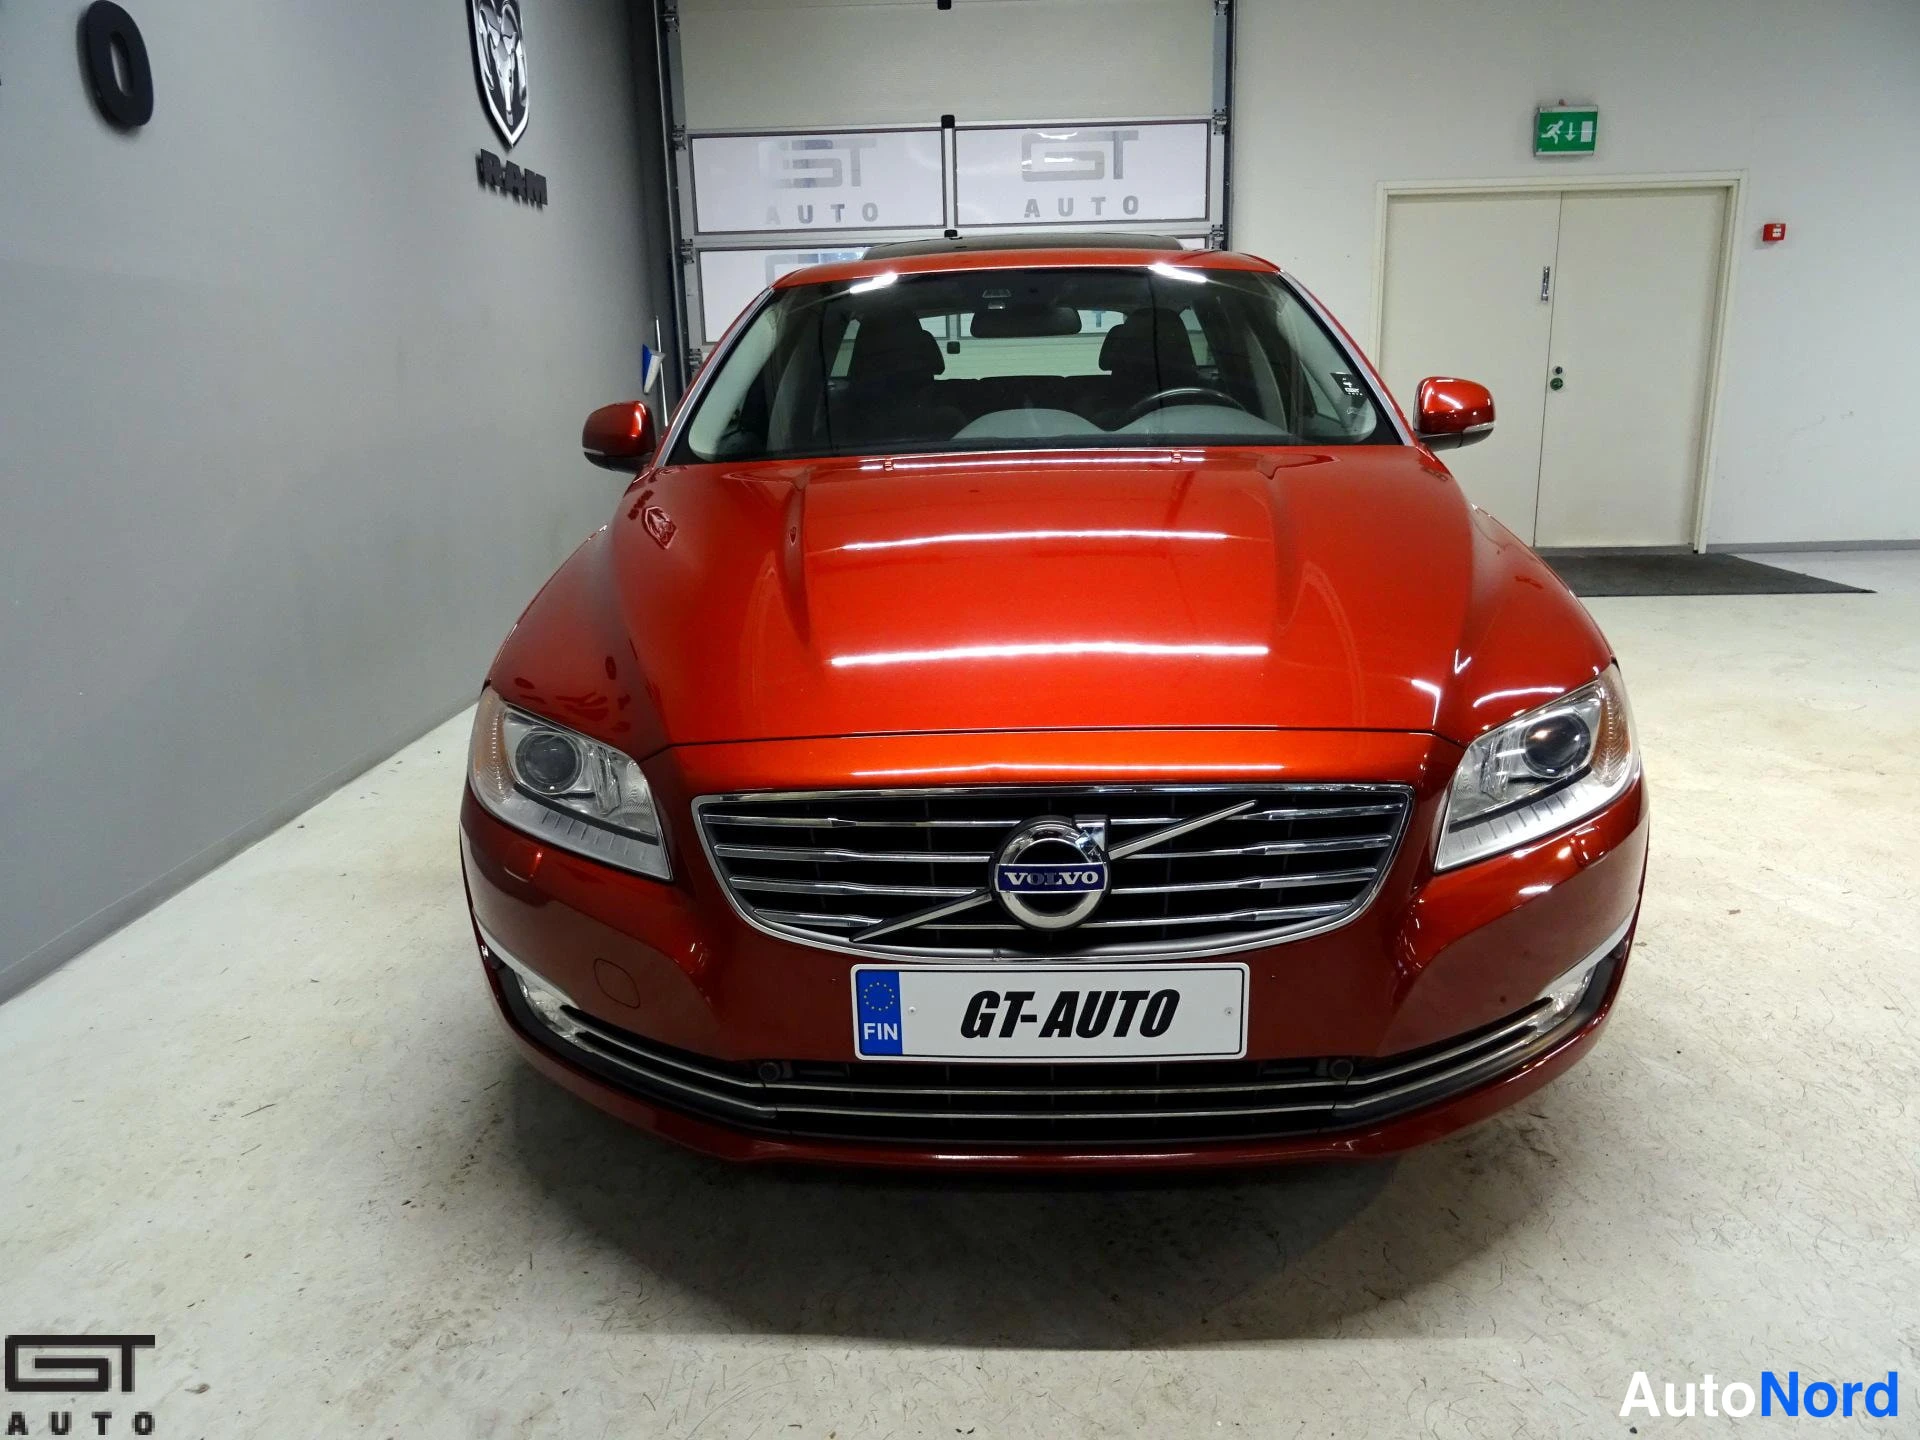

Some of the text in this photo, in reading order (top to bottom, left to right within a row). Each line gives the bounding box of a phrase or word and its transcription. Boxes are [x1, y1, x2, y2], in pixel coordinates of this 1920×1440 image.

[1021, 130, 1139, 182] GT
[477, 149, 548, 206] RAM
[764, 201, 879, 226] AUTO
[1023, 195, 1140, 219] AUTO
[1003, 870, 1100, 886] VOLVO
[863, 988, 1181, 1041] FIN GT-AUTO
